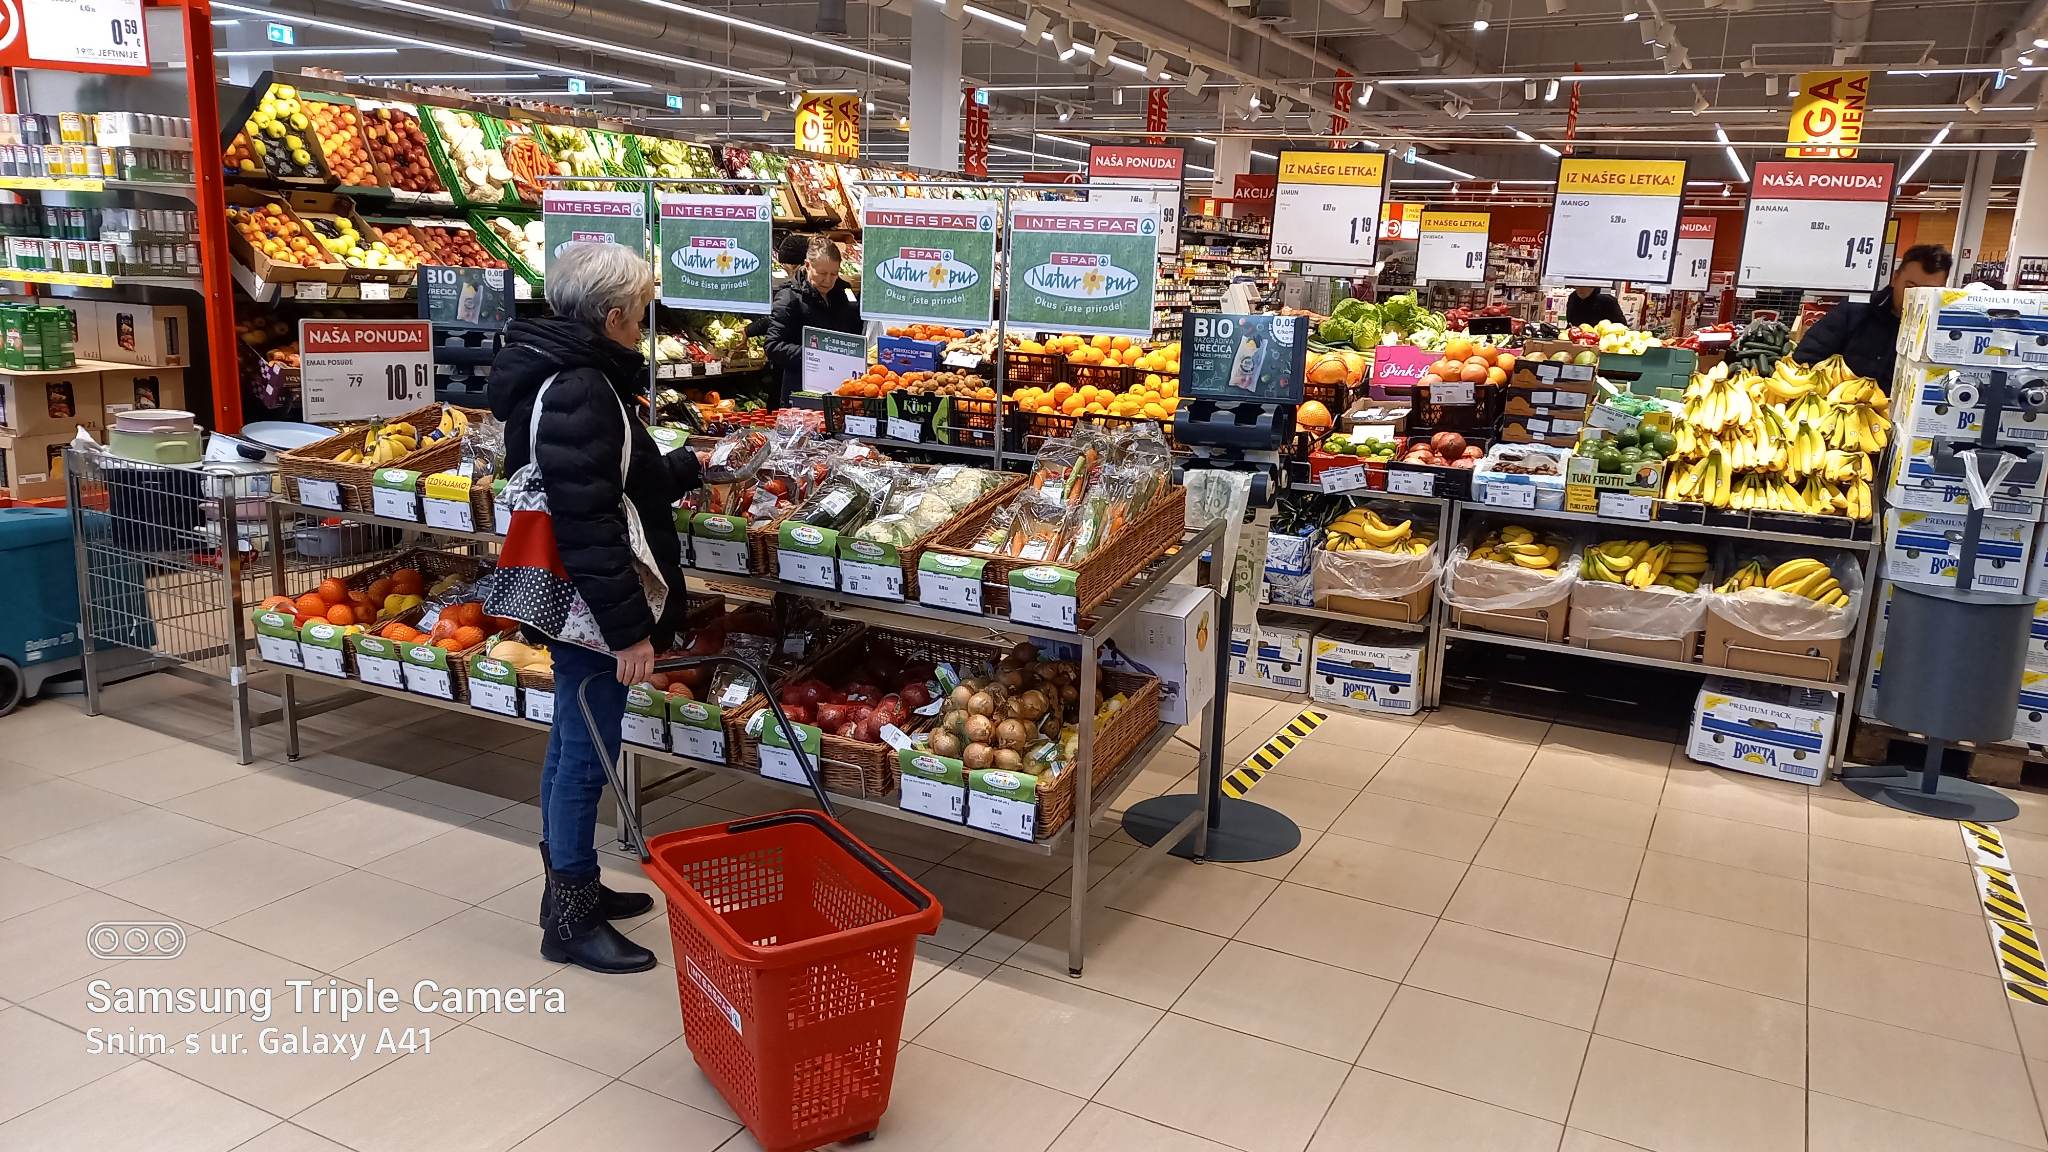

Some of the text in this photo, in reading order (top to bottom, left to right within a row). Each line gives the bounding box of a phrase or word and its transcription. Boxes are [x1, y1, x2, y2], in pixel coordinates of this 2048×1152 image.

[98, 49, 138, 59] JEFTINIJE
[1096, 153, 1176, 169] NAŠA PONUDA!
[1284, 160, 1377, 177] IZ NAŠEG LETKA!
[1566, 170, 1676, 186] IZ NAŠEG LETKA!
[1762, 171, 1883, 189] NAŠA PONUDA!
[552, 202, 631, 214] INTERSPAR
[670, 206, 756, 218] INTERSPAR
[877, 213, 976, 227] INTERSPAR
[1026, 217, 1137, 231] INTERSPAR
[1459, 220, 1485, 228] LETKA!
[579, 234, 605, 242] SPAR
[698, 239, 727, 248] SPAR
[908, 249, 941, 259] SPAR
[1276, 245, 1293, 255] 106
[677, 248, 758, 274] Natur pur
[1060, 255, 1097, 265] SPAR
[427, 269, 457, 285] BIO
[881, 259, 977, 288] Natur pur
[1030, 265, 1136, 296] Natur pur
[681, 274, 699, 287] Okus
[720, 279, 750, 291] prirode!
[886, 288, 965, 307] Okus prirode!
[1034, 296, 1123, 314] Okus prirode!
[1967, 295, 2037, 305] PREMIUM PACK
[309, 326, 422, 343] NAŠA PONUDA!
[1194, 317, 1234, 339] BIO
[1380, 363, 1415, 378] Pink
[348, 376, 363, 388] 79
[385, 363, 428, 401] 10,61
[903, 397, 932, 414] Kiwi
[426, 476, 470, 491] IZDVAJAMO!
[1572, 473, 1624, 487] TUKI FRUTTI
[1262, 631, 1279, 639] PACK
[1335, 646, 1367, 656] PREMIUM
[1343, 682, 1378, 702] BONITA
[1729, 702, 1793, 720] PREMIUM PACK
[1732, 741, 1778, 767] BONITA
